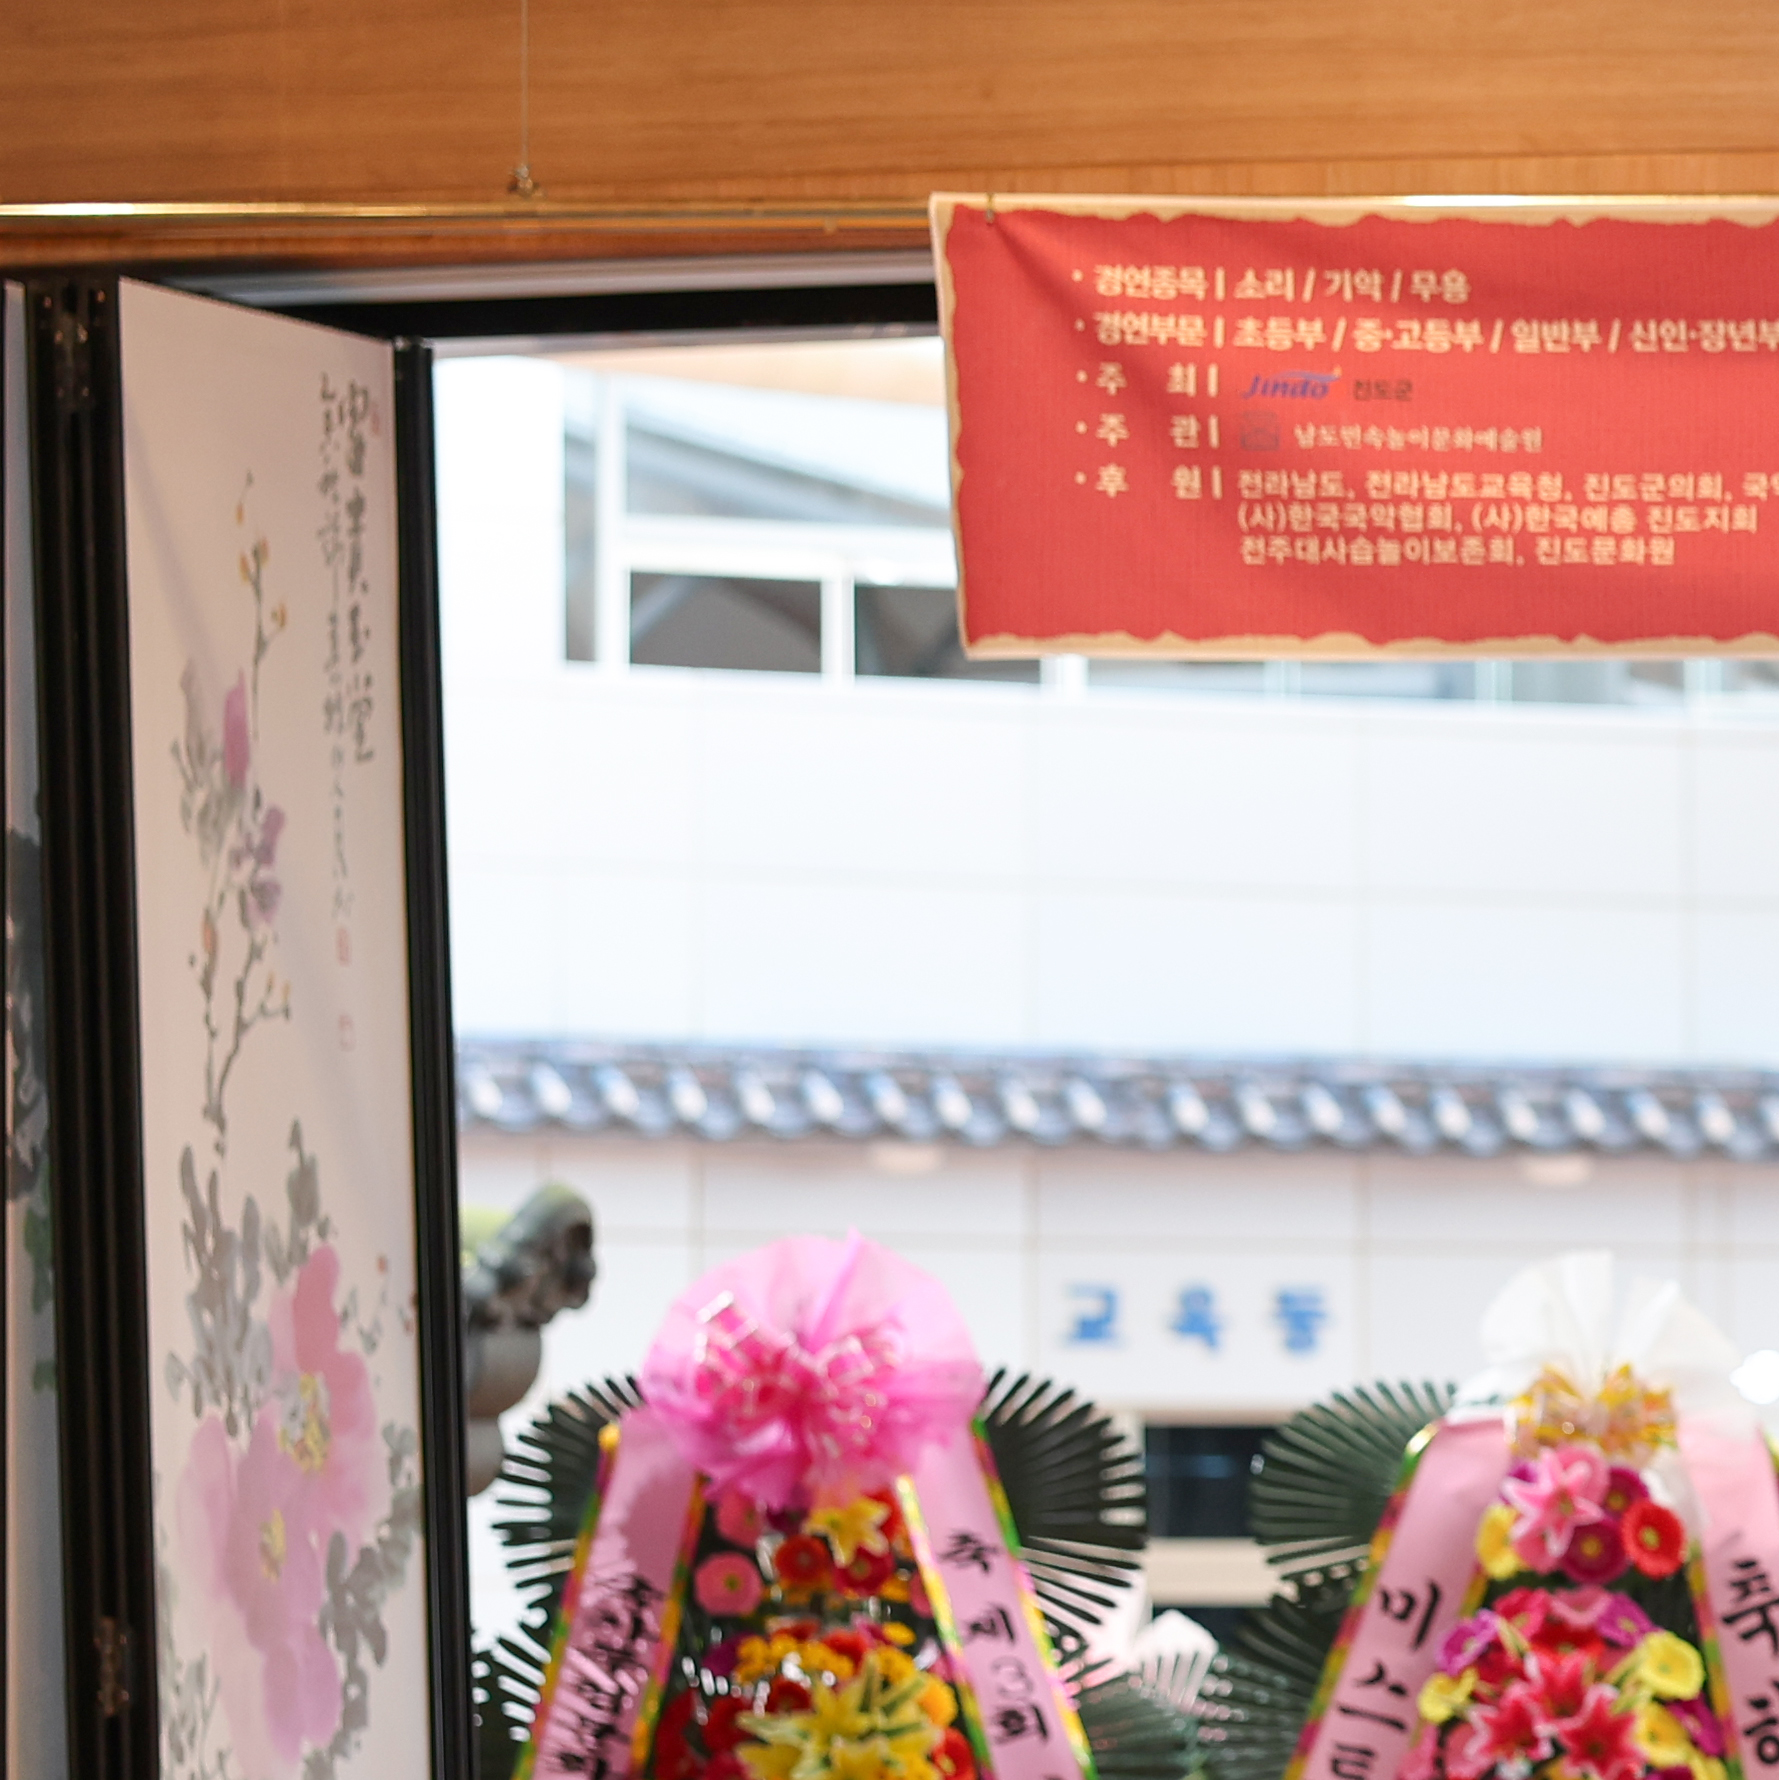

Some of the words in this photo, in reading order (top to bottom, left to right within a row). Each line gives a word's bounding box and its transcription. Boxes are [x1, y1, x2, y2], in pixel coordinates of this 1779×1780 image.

[1095, 265, 1208, 300] 경연종목
[1234, 269, 1294, 302] 소리
[1325, 269, 1382, 302] 기악
[1411, 269, 1469, 303] 무용
[1096, 310, 1208, 347] 경연부문
[1234, 317, 1326, 350] 초등부
[1352, 318, 1484, 353] 중·고등부
[1511, 319, 1602, 354] 일반부
[1646, 503, 1758, 535] 진도지회
[1535, 535, 1675, 567] 진도문화원
[1062, 1283, 1330, 1355] 교육동
